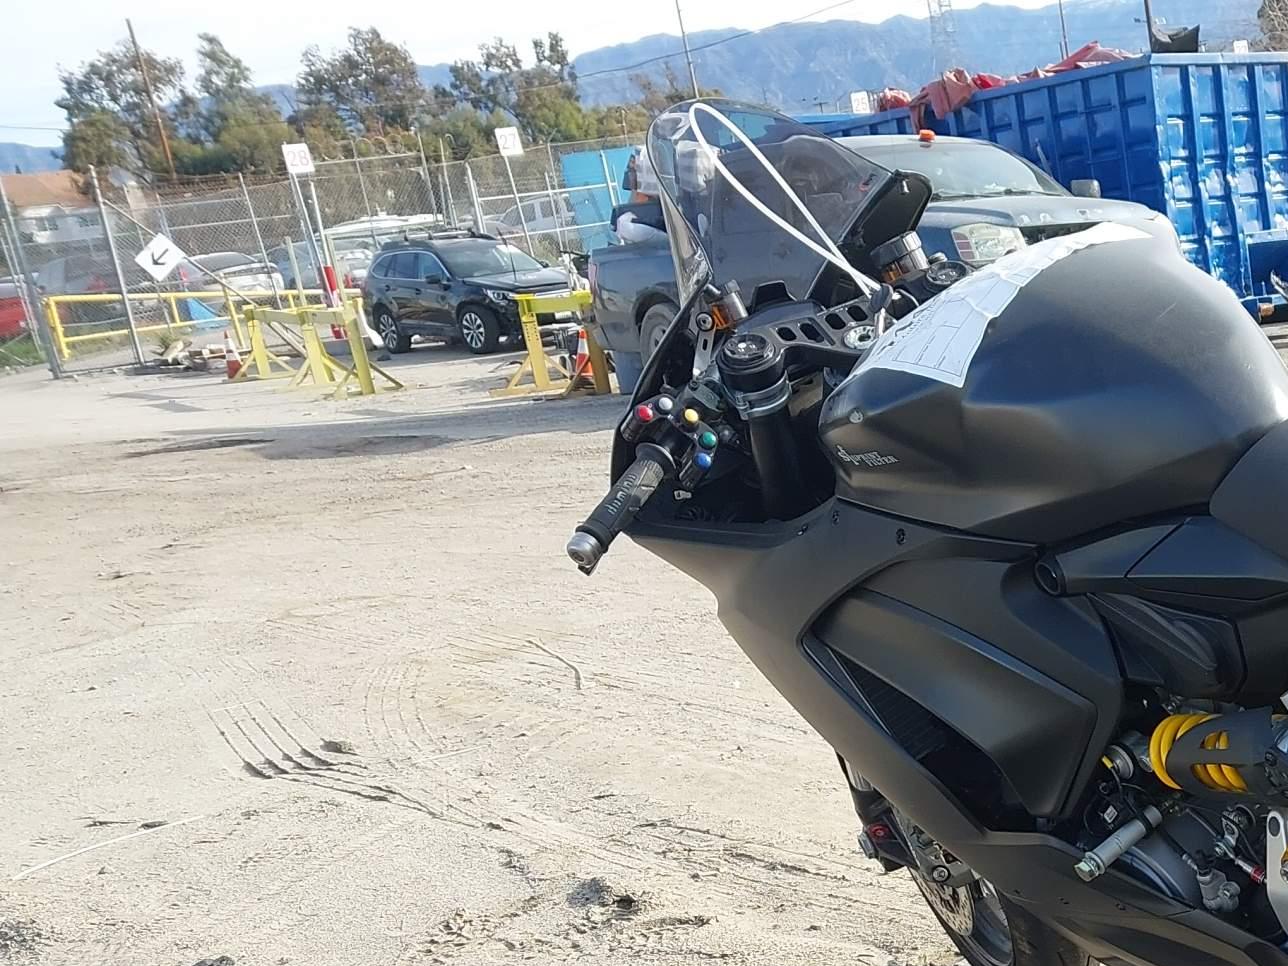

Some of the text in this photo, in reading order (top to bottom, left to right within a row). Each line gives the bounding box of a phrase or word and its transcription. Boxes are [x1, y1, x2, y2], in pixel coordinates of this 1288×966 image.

[854, 97, 868, 112] 25
[499, 133, 517, 150] 27
[286, 149, 310, 167] 28
[604, 473, 637, 516] domino
